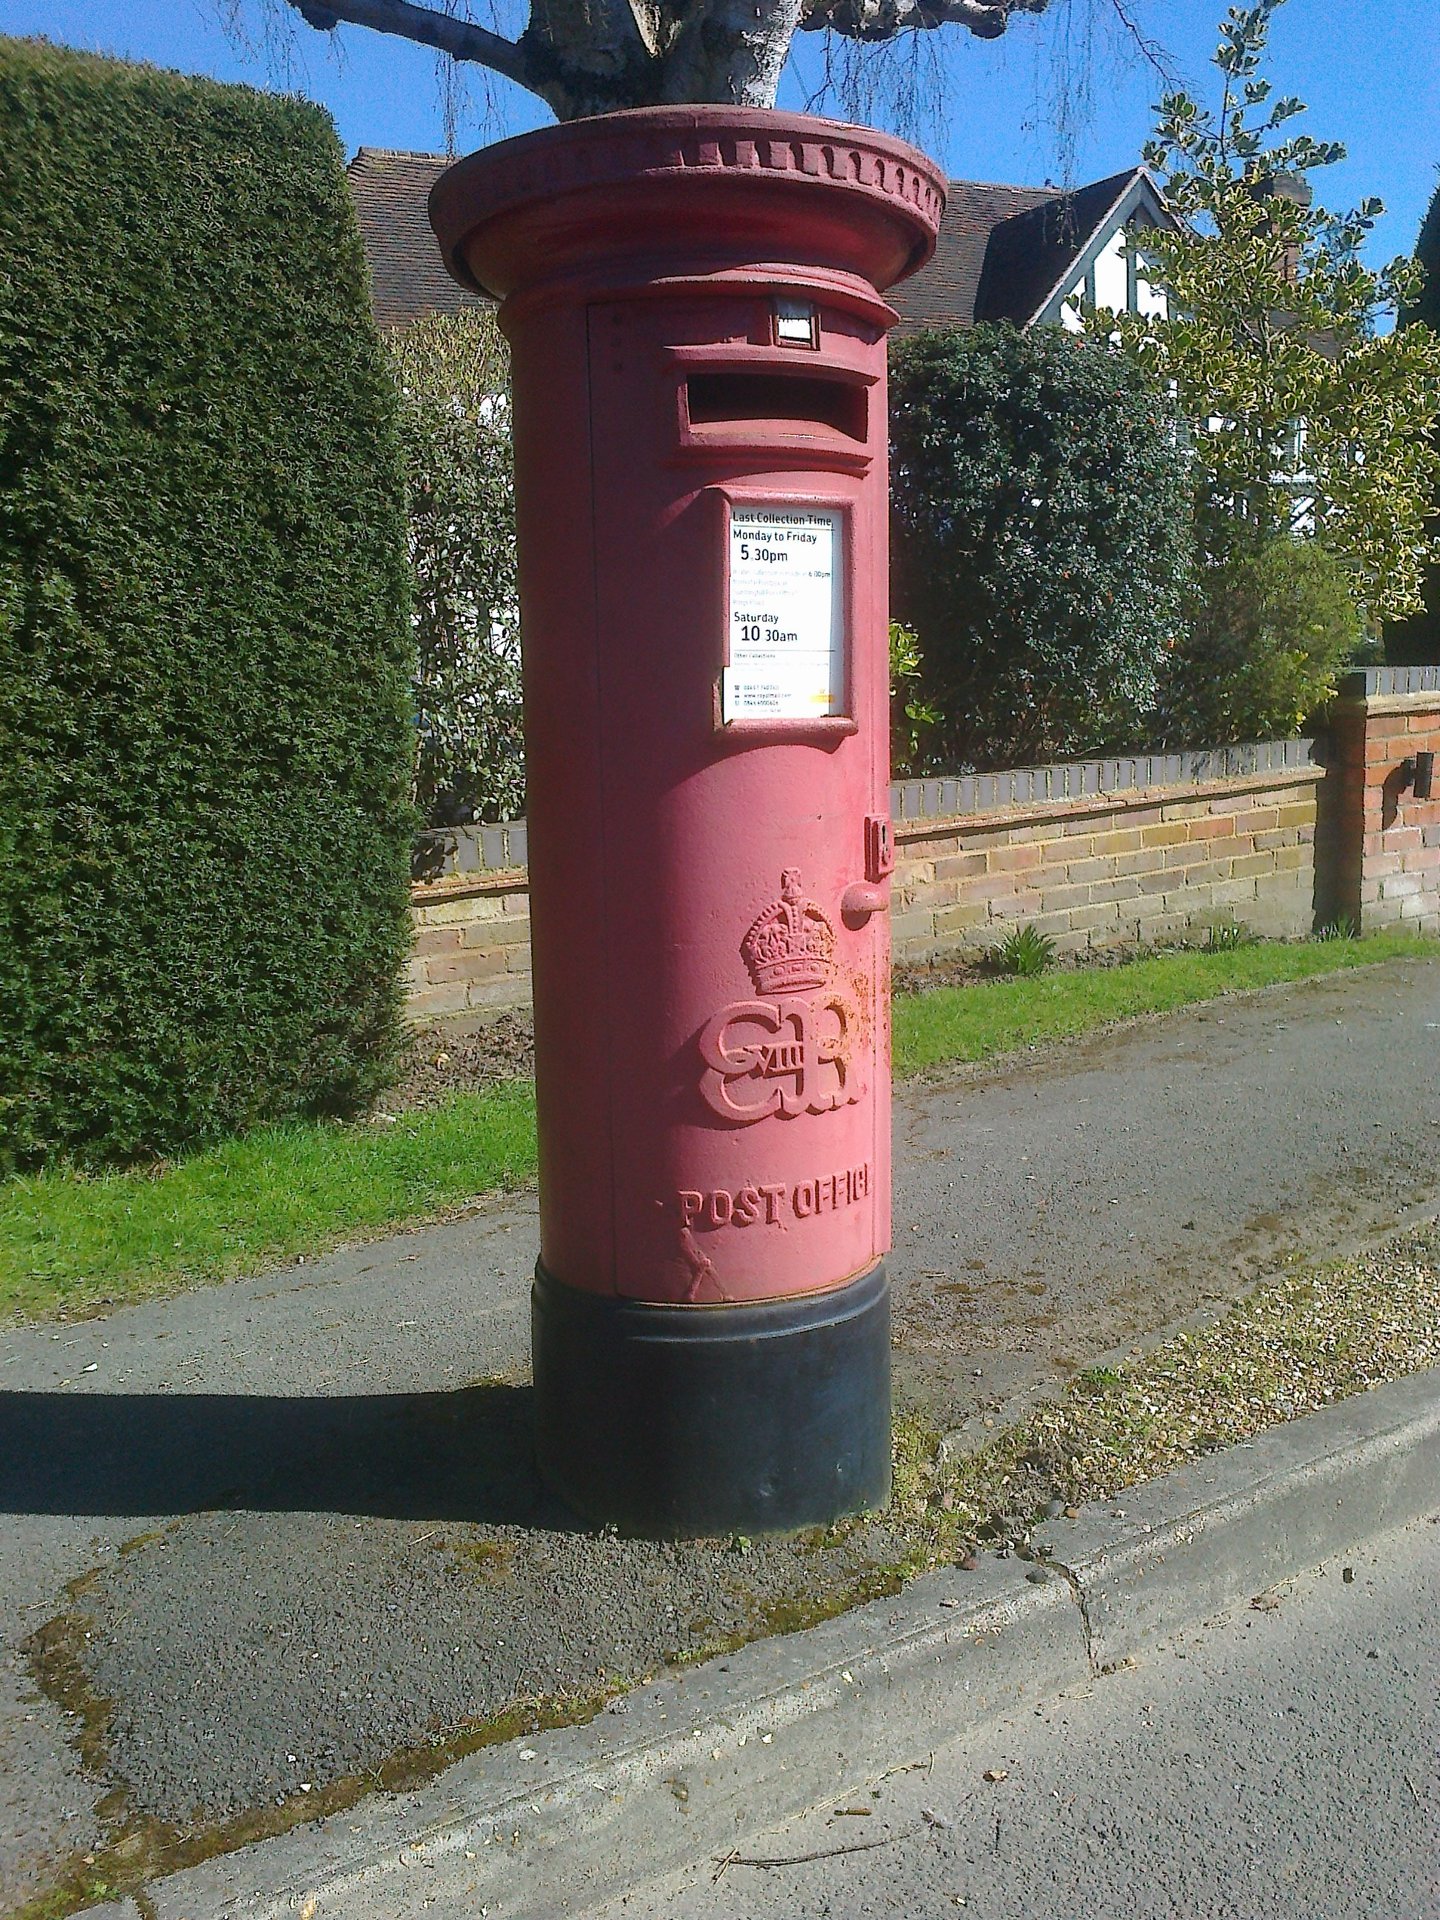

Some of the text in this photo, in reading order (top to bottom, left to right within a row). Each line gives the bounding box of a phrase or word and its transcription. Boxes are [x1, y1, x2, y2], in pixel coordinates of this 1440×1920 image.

[732, 511, 832, 526] Last Collection Time
[733, 529, 817, 544] Monday to Friday
[734, 611, 779, 625] Saturday
[678, 1160, 874, 1227] POST OFFICE
